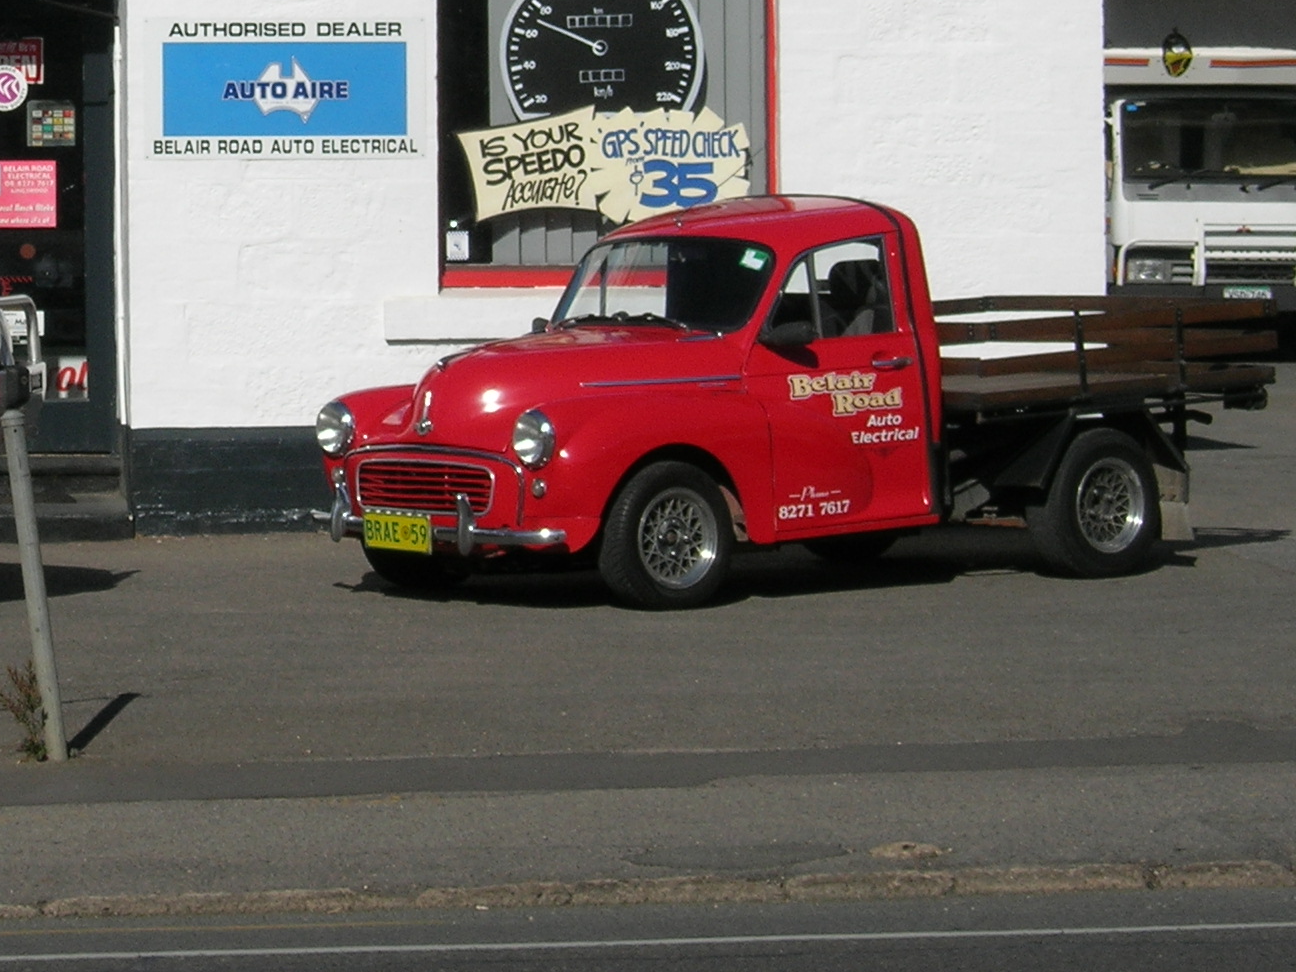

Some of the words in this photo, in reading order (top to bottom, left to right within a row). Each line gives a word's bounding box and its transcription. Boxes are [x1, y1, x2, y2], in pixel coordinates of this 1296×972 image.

[168, 22, 307, 38] AUTHORISED
[316, 22, 403, 37] DEALER
[525, 29, 539, 39] 60
[522, 60, 537, 70] 40
[664, 61, 682, 71] 200
[222, 81, 287, 100] AUTO
[292, 81, 349, 99] AIRE
[656, 92, 674, 103] 220
[535, 95, 548, 104] 20
[153, 139, 211, 155] BELAIR
[217, 139, 263, 154] ROAD
[270, 139, 315, 154] AUTO
[321, 138, 419, 154] ELECTRICAL
[479, 136, 509, 159] IS
[513, 121, 583, 152] YOUR
[643, 129, 691, 159] SPEED
[691, 129, 741, 159] CHECK
[31, 164, 54, 172] ROAD
[482, 143, 586, 186] SPEEDO
[7, 172, 51, 180] ELECTRICAL
[788, 371, 877, 400] Belair
[832, 386, 903, 417] Road
[866, 414, 903, 428] Auto
[851, 427, 920, 444] Electrical
[778, 503, 815, 520] 8271
[819, 499, 851, 516] 7617
[365, 517, 401, 544] BRAE
[409, 524, 428, 546] 59
